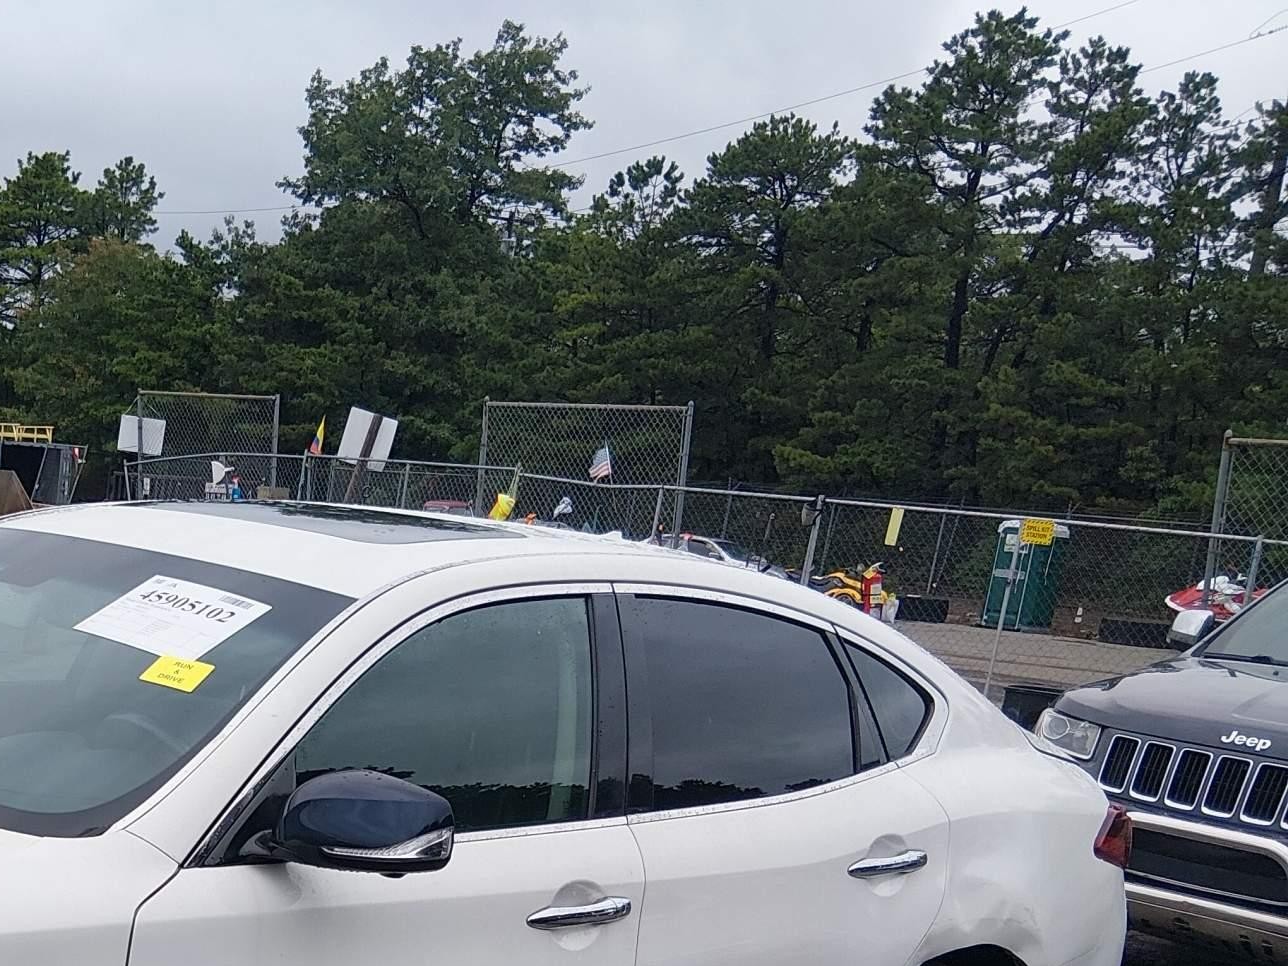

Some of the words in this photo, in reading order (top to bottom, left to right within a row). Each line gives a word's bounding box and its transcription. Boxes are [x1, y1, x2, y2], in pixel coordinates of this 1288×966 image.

[140, 591, 236, 623] 45905102
[173, 661, 194, 670] RUN
[158, 673, 185, 683] DRIVE
[1220, 730, 1272, 751] Jeep
